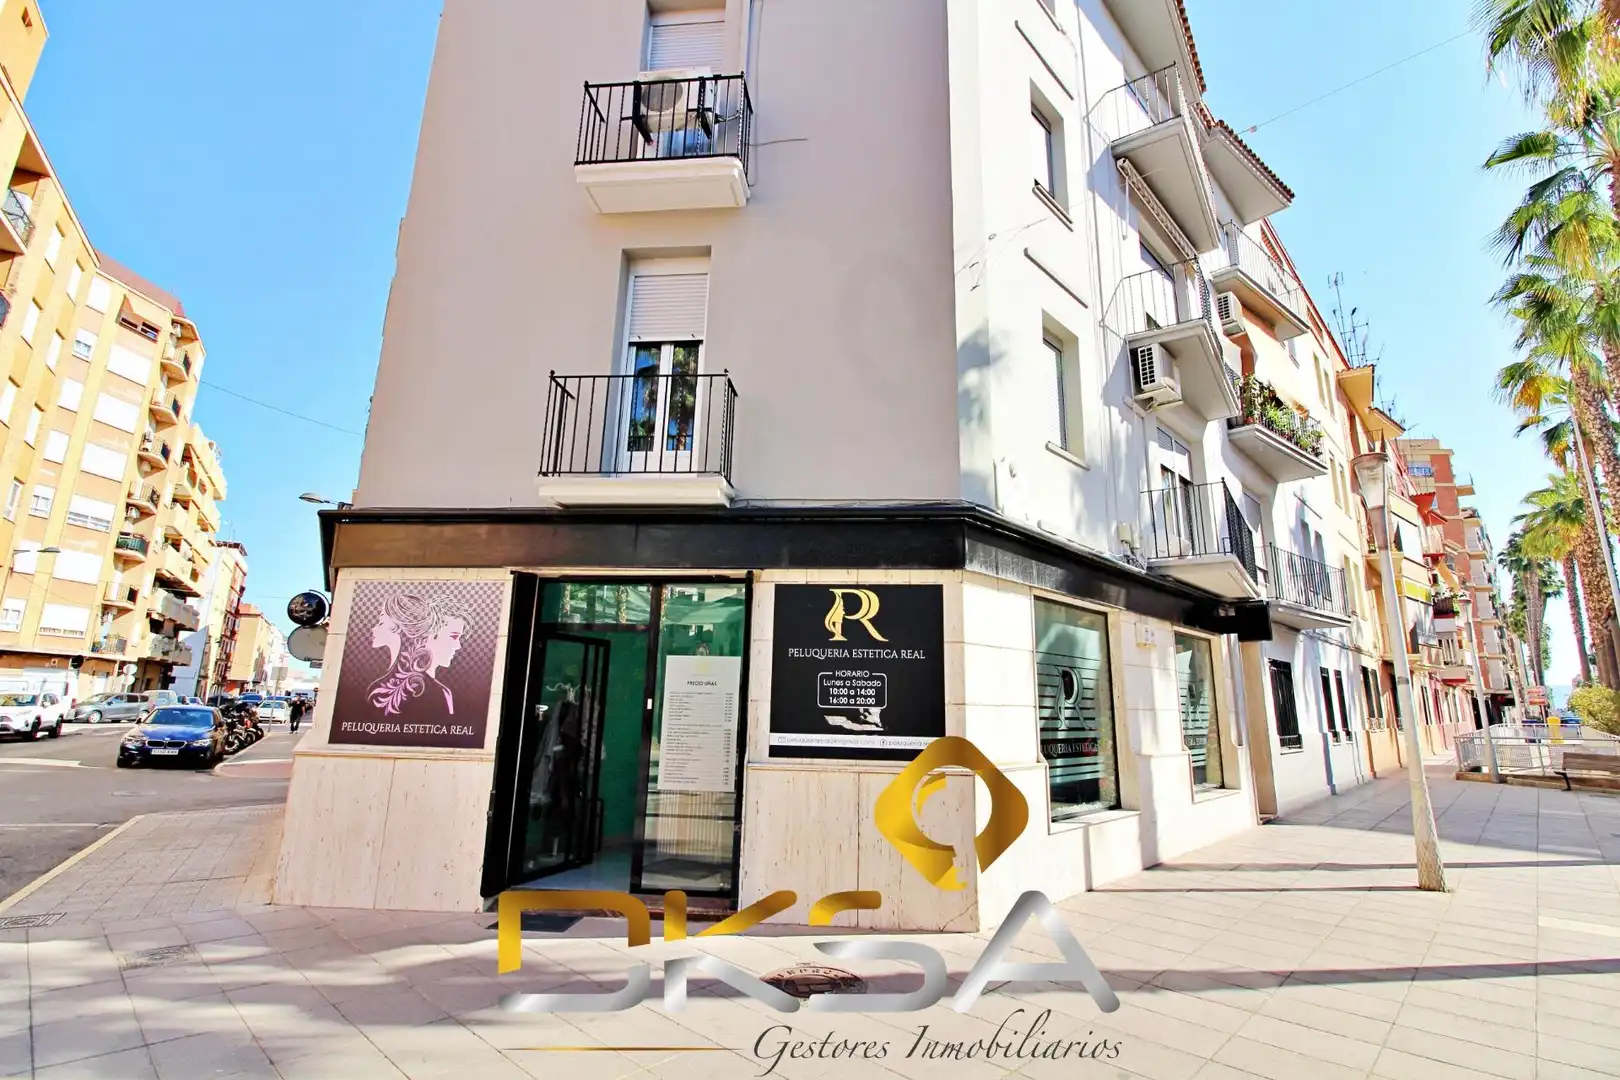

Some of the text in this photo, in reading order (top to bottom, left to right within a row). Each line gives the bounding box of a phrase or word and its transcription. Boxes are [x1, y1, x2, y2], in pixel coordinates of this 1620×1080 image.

[852, 649, 898, 659] ESTETICA
[900, 650, 926, 660] REAL
[835, 669, 870, 678] HORARIO
[823, 678, 844, 687] Lunes
[829, 688, 849, 696] 10:00
[856, 688, 876, 697] 14:00
[829, 697, 849, 705] 16:00
[856, 697, 876, 705] 20:00
[341, 722, 475, 736] PELUQUERIA ESTETICA REAL
